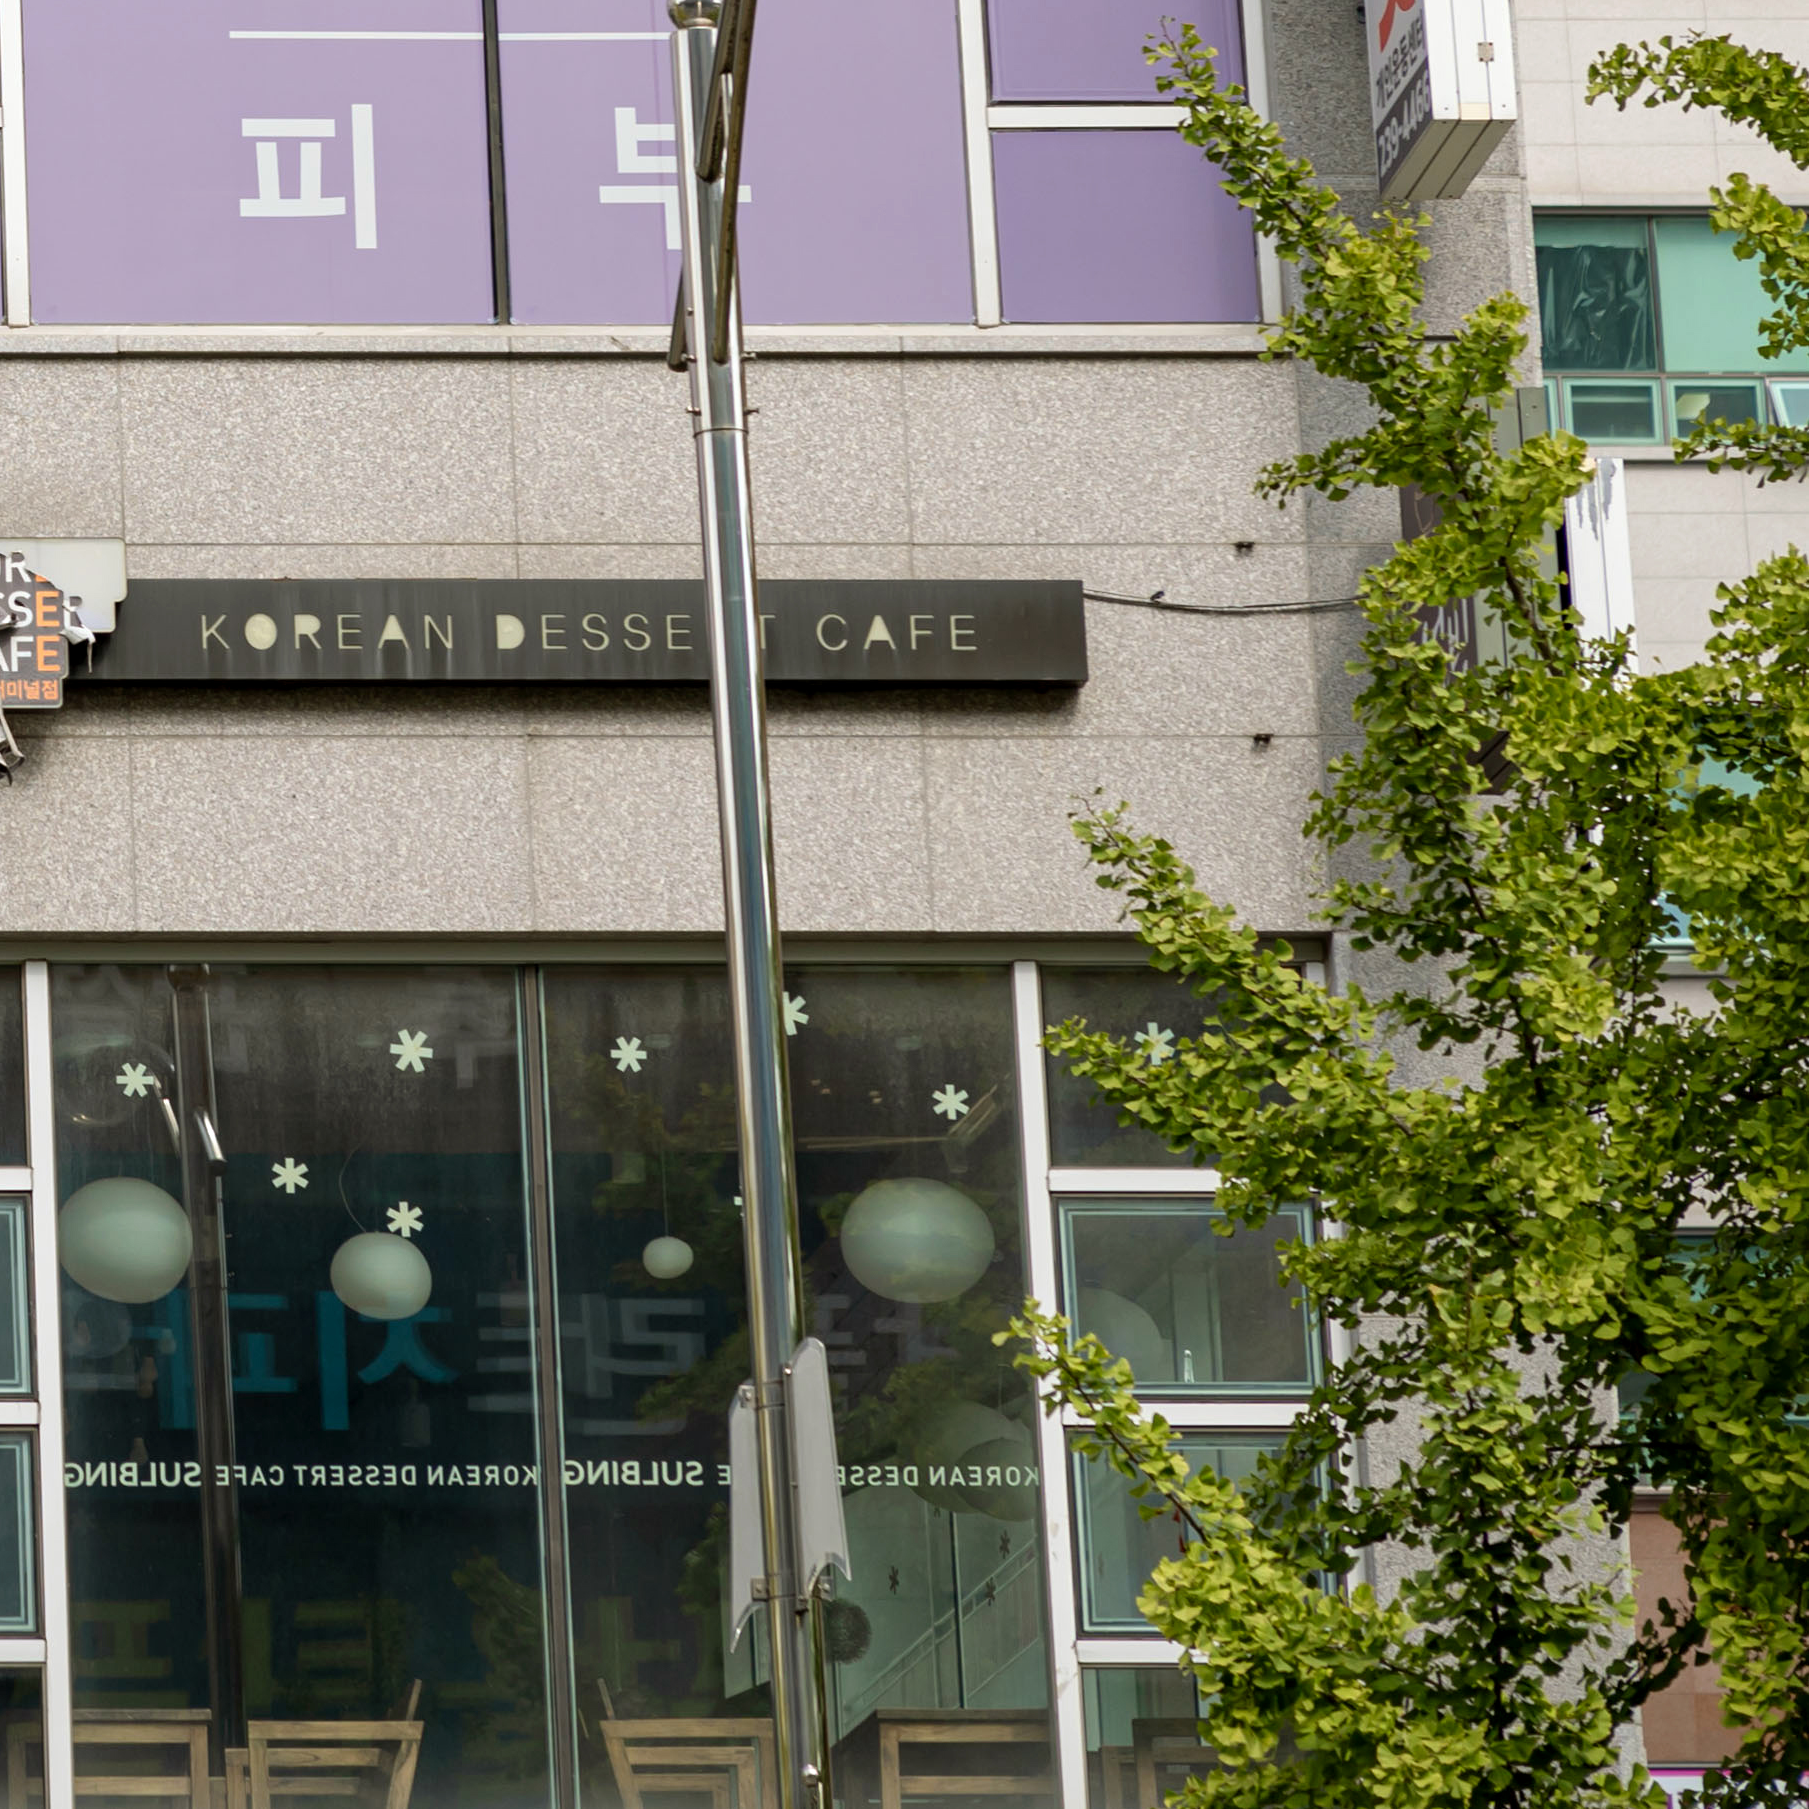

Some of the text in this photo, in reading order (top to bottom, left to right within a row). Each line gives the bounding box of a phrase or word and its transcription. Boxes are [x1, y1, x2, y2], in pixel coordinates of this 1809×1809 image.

[1378, 68, 1432, 178] 239-4466
[200, 612, 979, 652] KOREAN DESSET CAFE
